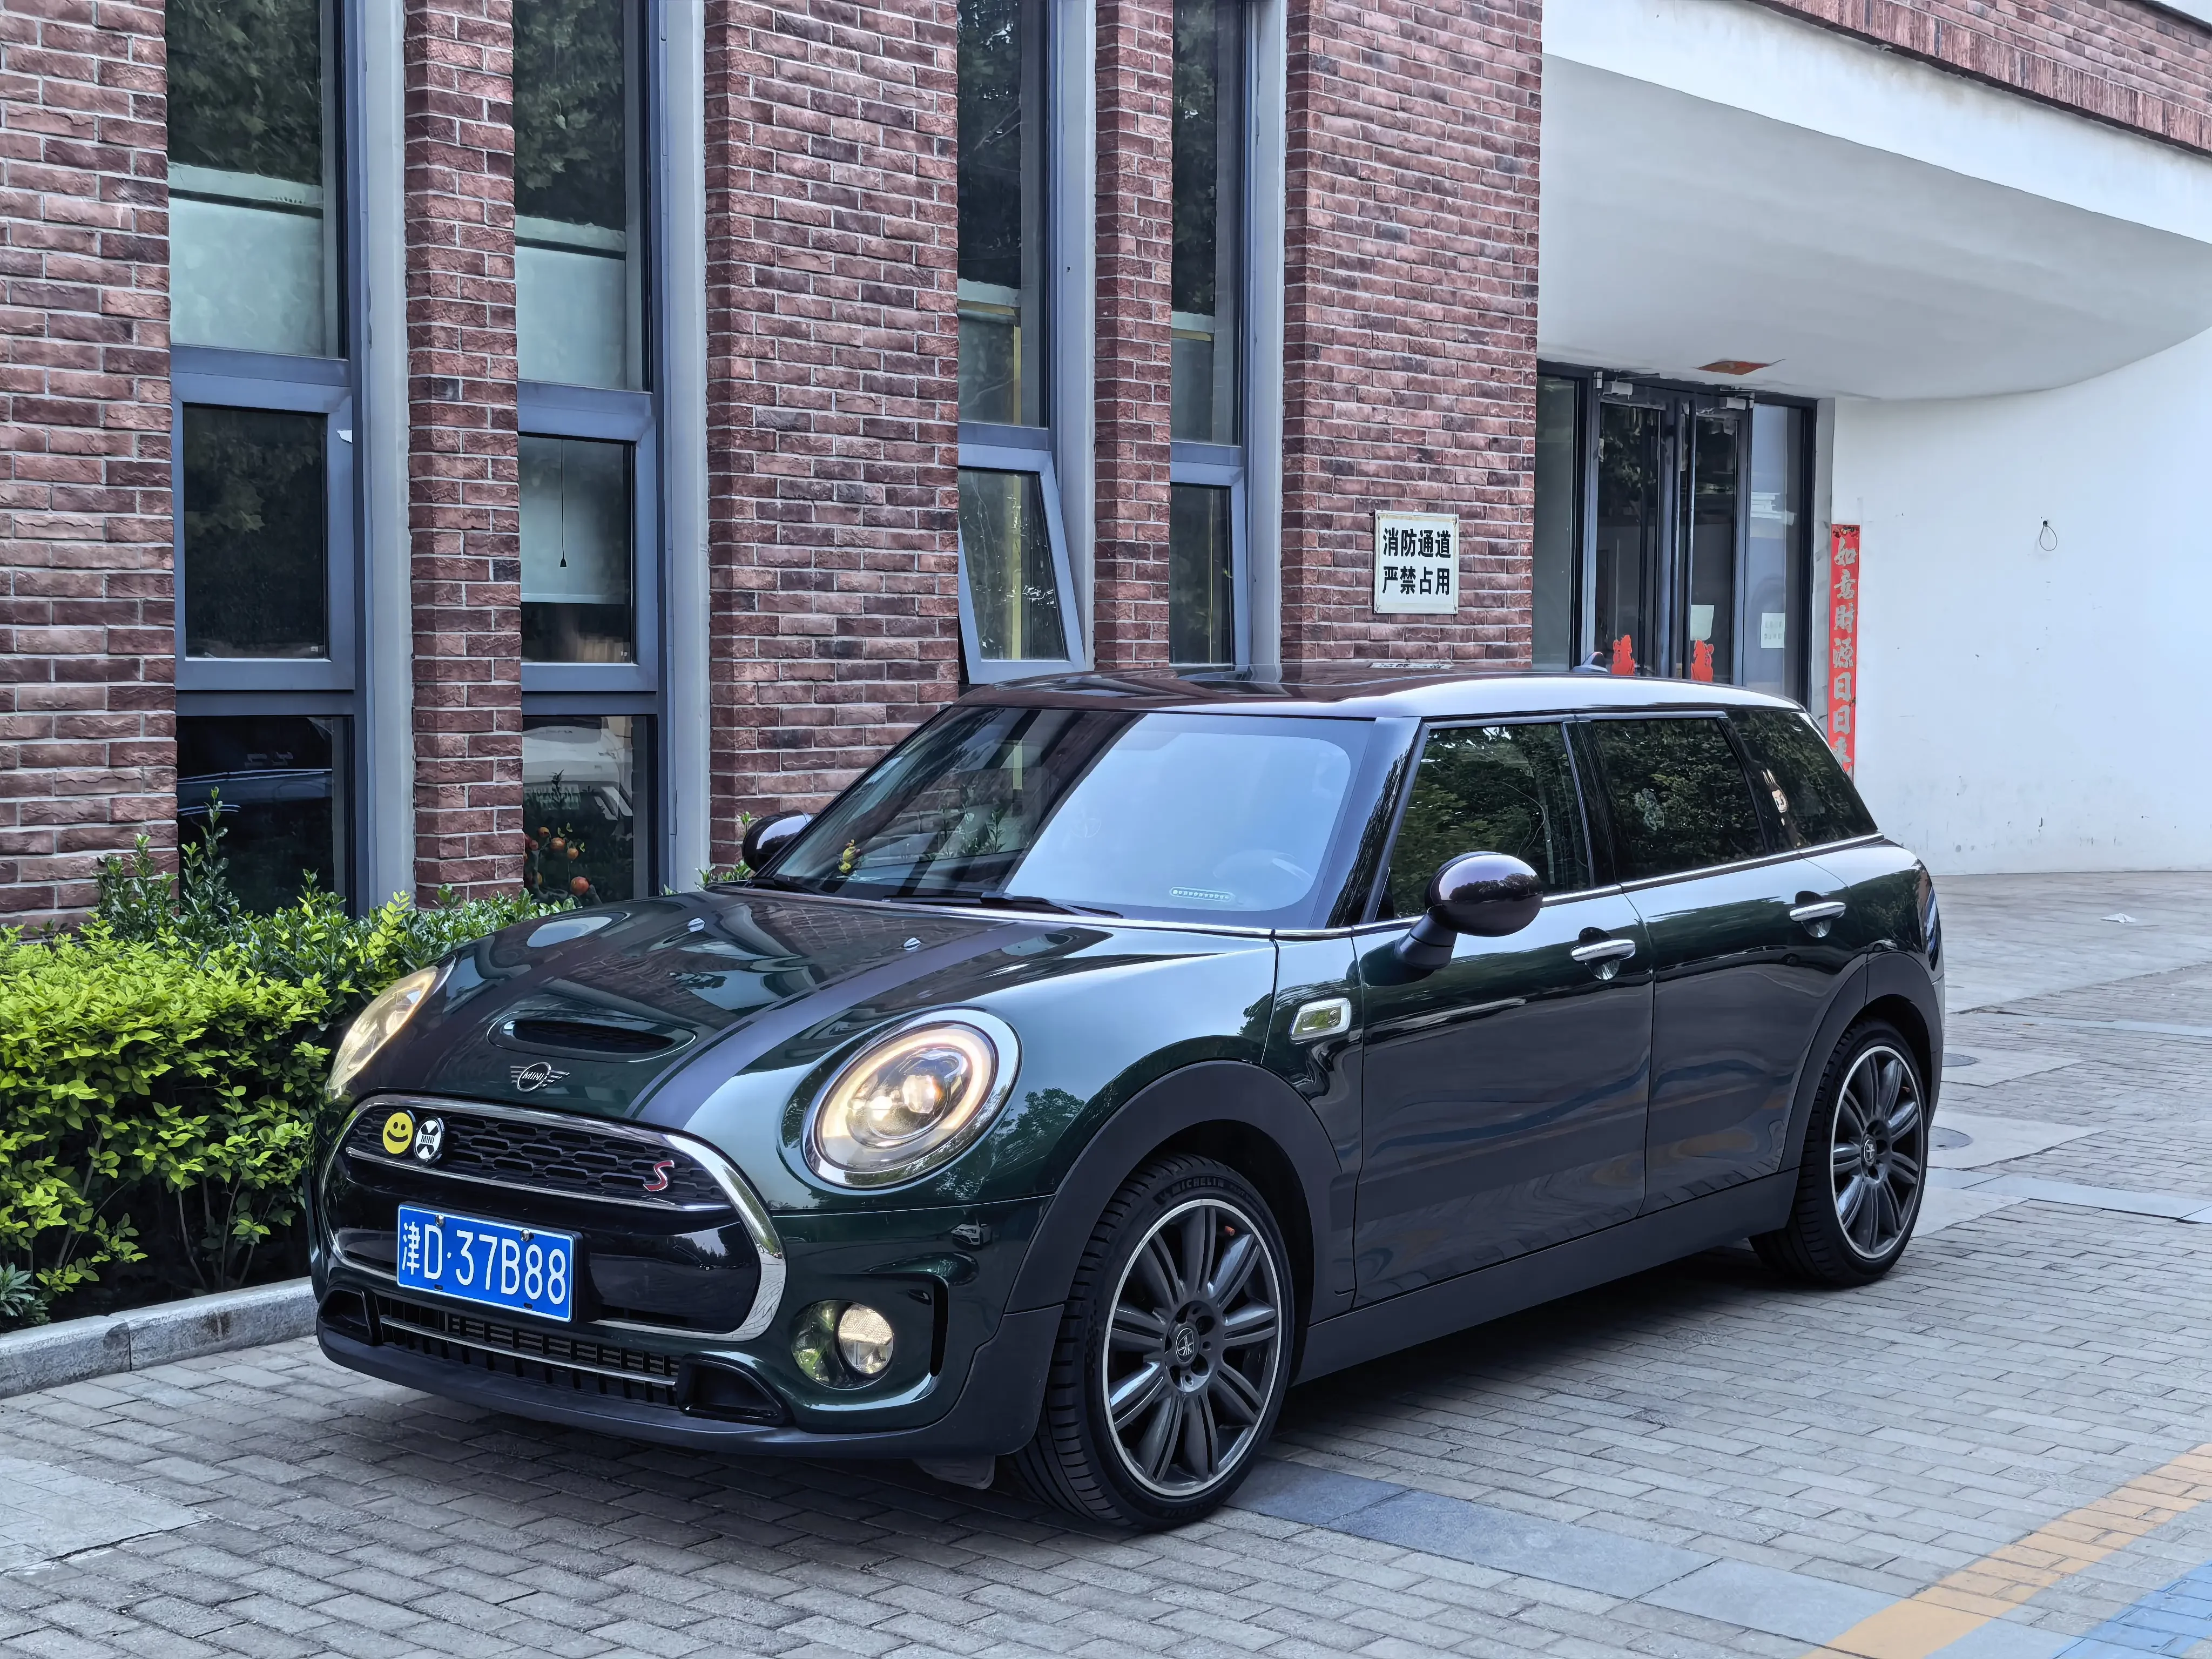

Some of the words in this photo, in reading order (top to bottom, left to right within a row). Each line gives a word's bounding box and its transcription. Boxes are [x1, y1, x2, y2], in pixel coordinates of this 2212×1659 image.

[1383, 528, 1451, 558] 消防通道
[1382, 566, 1450, 595] 严禁占用
[522, 1071, 545, 1081] MINI
[421, 1135, 435, 1144] MINI
[643, 1159, 675, 1191] S
